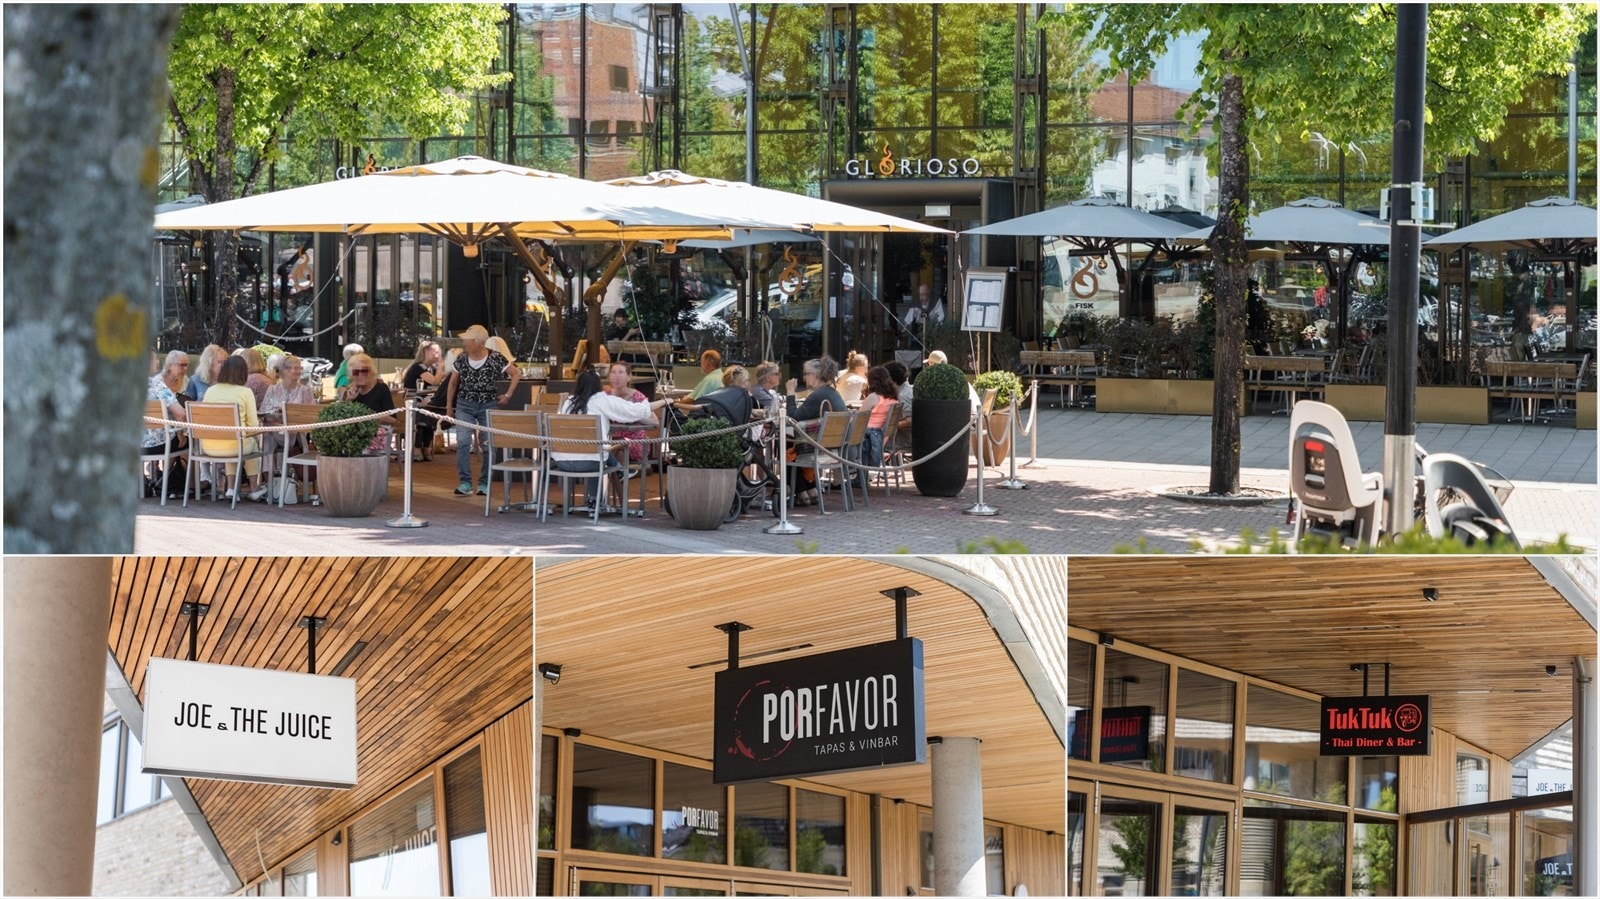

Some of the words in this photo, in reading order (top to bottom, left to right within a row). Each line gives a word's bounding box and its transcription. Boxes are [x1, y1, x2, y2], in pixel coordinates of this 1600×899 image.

[846, 145, 979, 176] GLORIOSO
[763, 674, 898, 744] PORFAVOR
[1327, 707, 1392, 729] TukTuk
[174, 701, 213, 729] JOE
[217, 722, 228, 731] &
[230, 706, 268, 734] THE
[275, 711, 332, 740] JUICE
[814, 742, 846, 756] TAPAS
[849, 741, 856, 751] &
[859, 735, 899, 750] VINBAR
[1332, 737, 1353, 747] Thai
[1356, 737, 1384, 747] Diner
[1386, 737, 1394, 747] &
[1397, 737, 1416, 747] Bar
[1535, 782, 1549, 792] JOE
[1542, 862, 1560, 876] JOE
